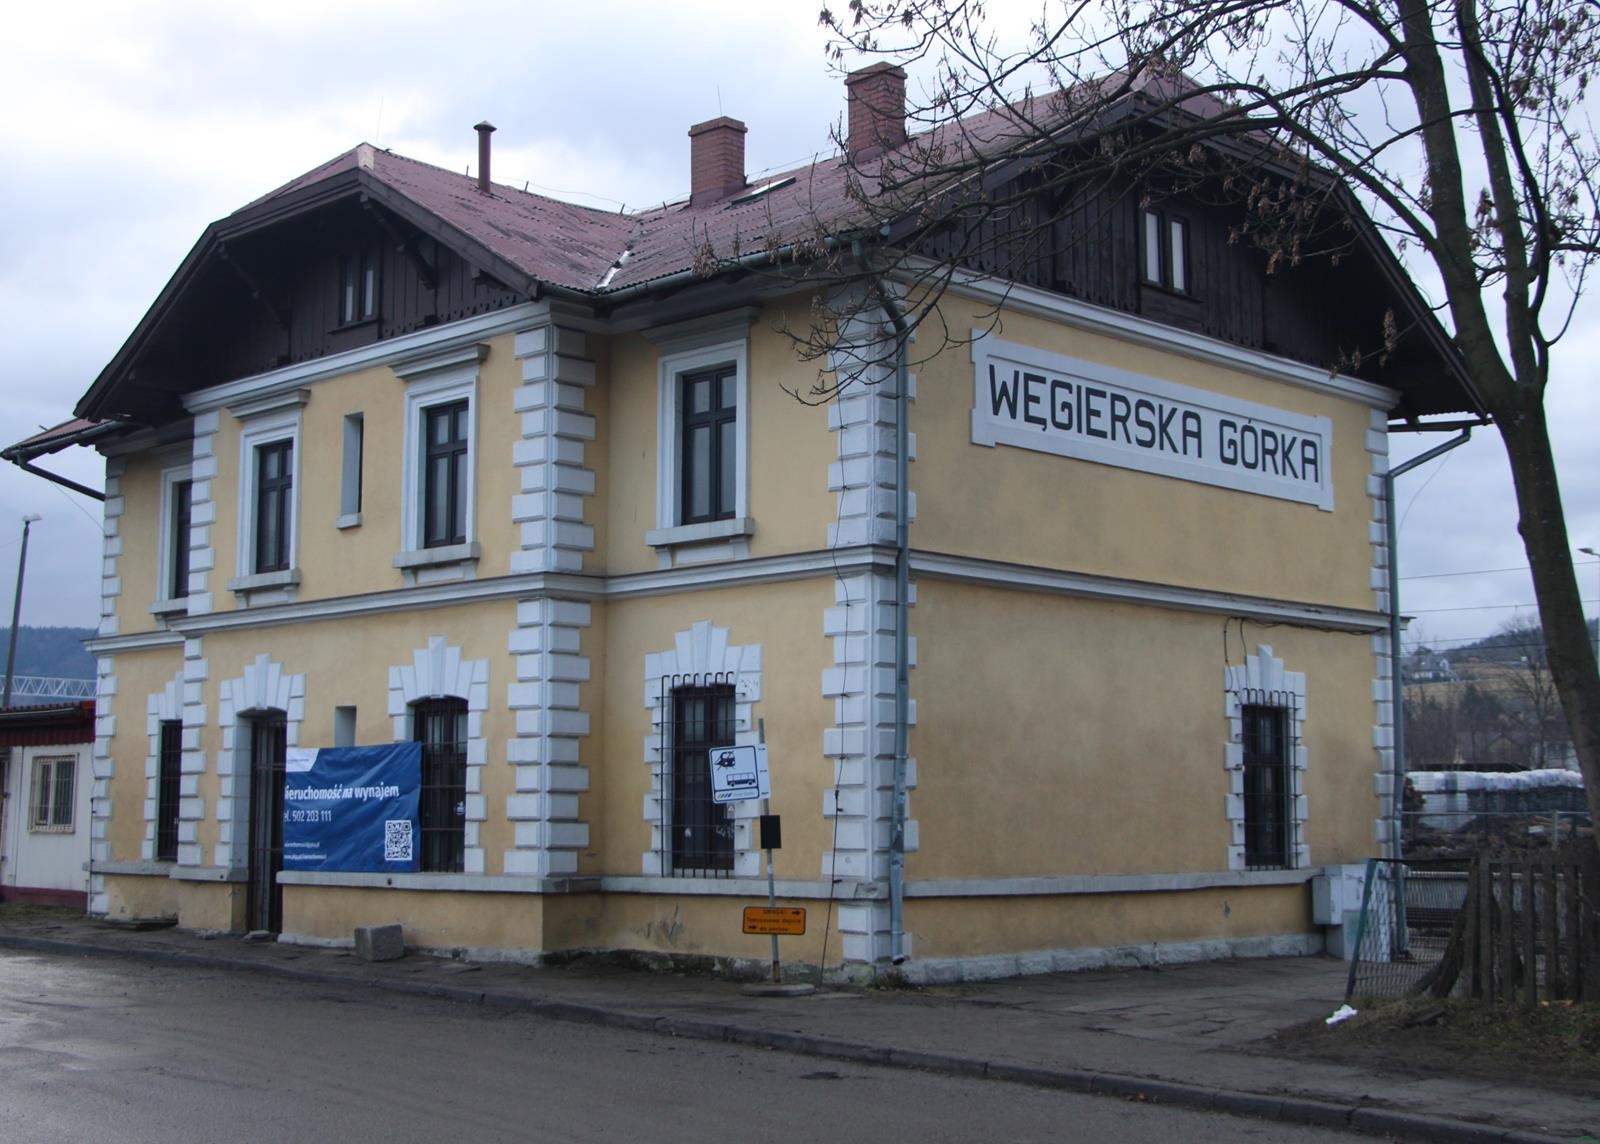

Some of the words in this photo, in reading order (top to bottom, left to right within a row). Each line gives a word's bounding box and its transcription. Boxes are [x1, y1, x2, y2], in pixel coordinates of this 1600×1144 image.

[988, 363, 1203, 459] WĘGIERSKA
[1218, 417, 1320, 484] GÓRKA
[342, 788, 353, 799] na
[354, 782, 399, 802] wynajem
[292, 810, 305, 822] 502
[306, 810, 319, 822] 203
[321, 809, 332, 821] 111
